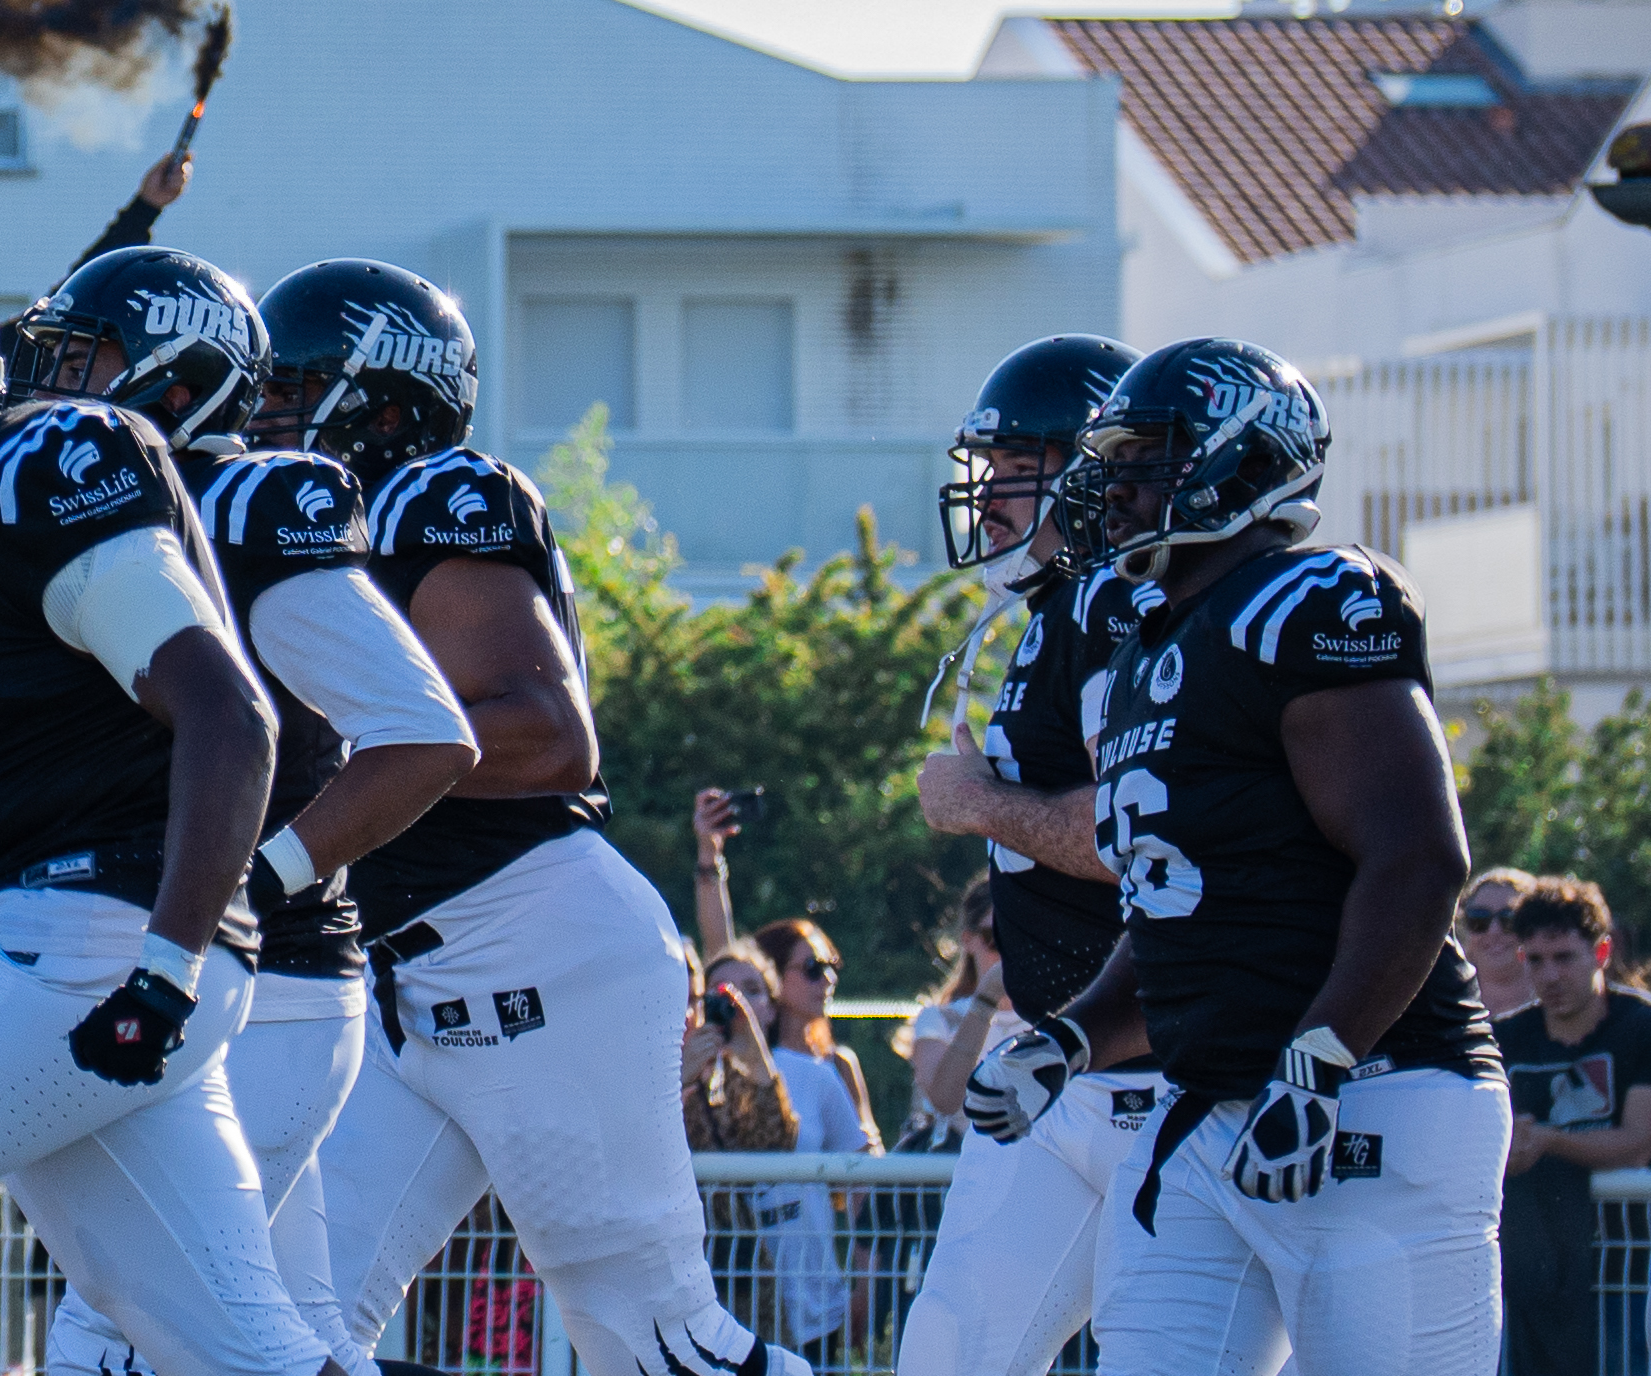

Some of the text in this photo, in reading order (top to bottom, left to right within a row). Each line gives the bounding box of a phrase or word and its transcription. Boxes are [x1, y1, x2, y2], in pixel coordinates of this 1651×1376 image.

[145, 292, 249, 353] OURS
[366, 332, 463, 377] OURS
[1207, 383, 1309, 434] OURS
[432, 1035, 499, 1048] TOULOUSE
[1359, 1063, 1383, 1078] 2XL
